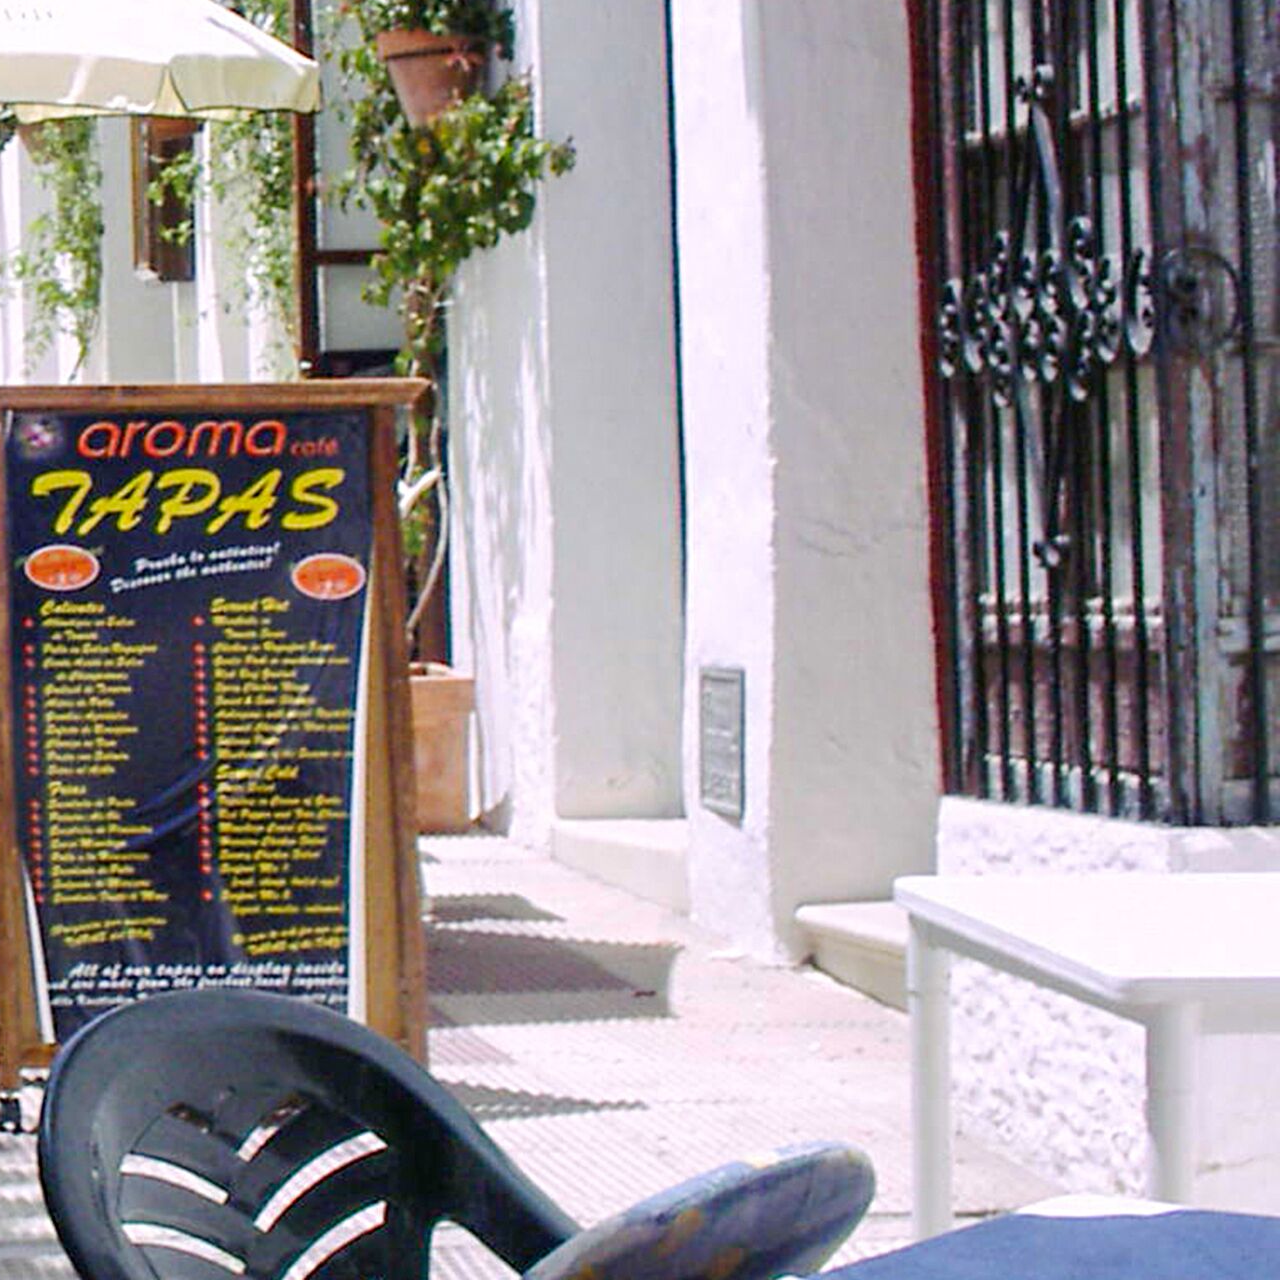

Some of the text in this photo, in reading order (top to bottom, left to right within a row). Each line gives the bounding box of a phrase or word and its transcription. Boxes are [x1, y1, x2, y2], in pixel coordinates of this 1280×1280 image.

[76, 420, 288, 458] aroma
[30, 467, 345, 535] TAPAS
[68, 961, 99, 979] All
